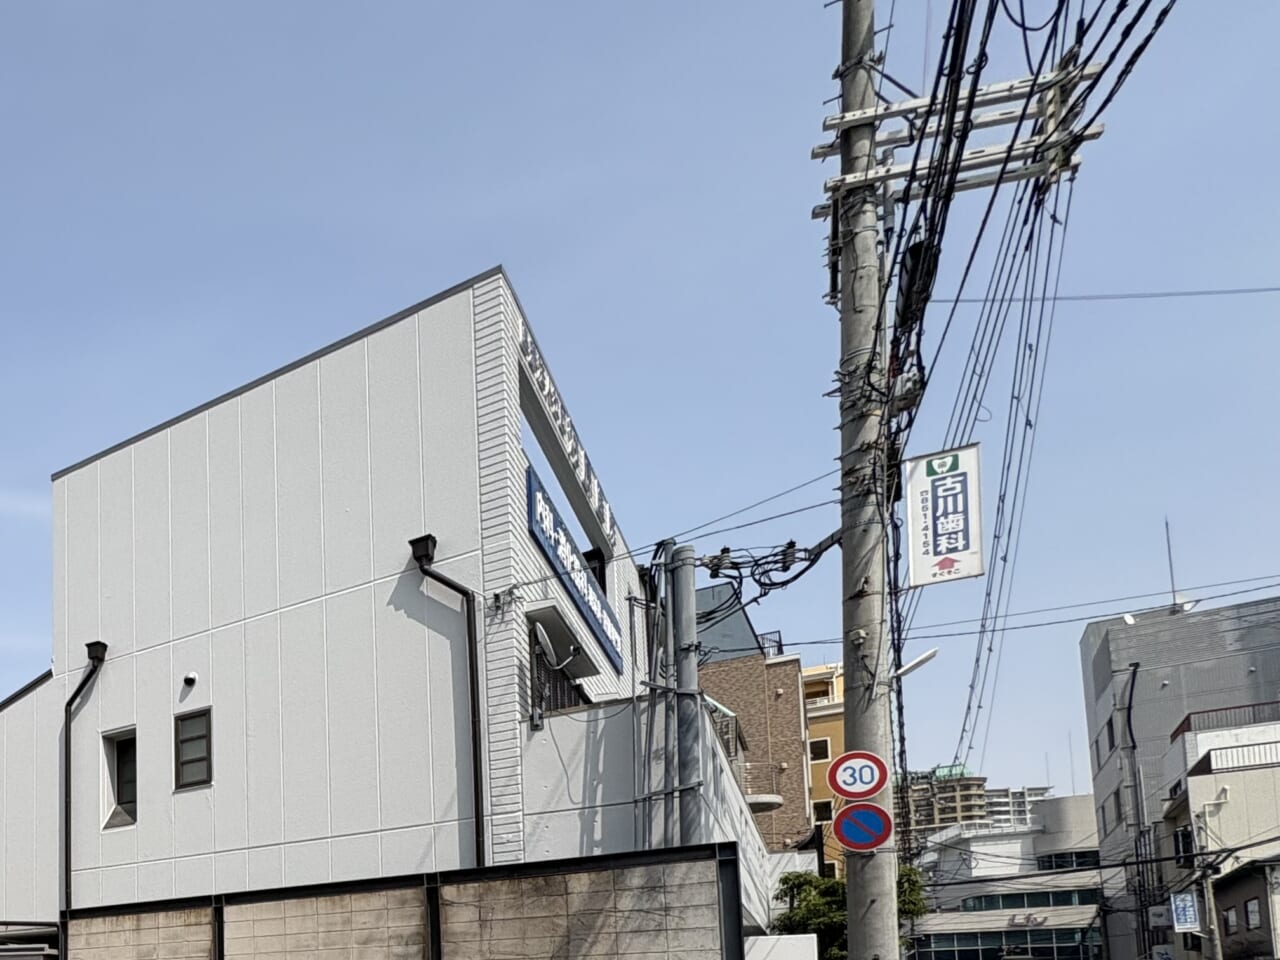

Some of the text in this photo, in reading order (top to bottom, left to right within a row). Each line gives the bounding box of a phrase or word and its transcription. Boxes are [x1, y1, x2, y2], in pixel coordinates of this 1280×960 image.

[934, 475, 966, 554] 古川歯科
[841, 764, 875, 786] 30
